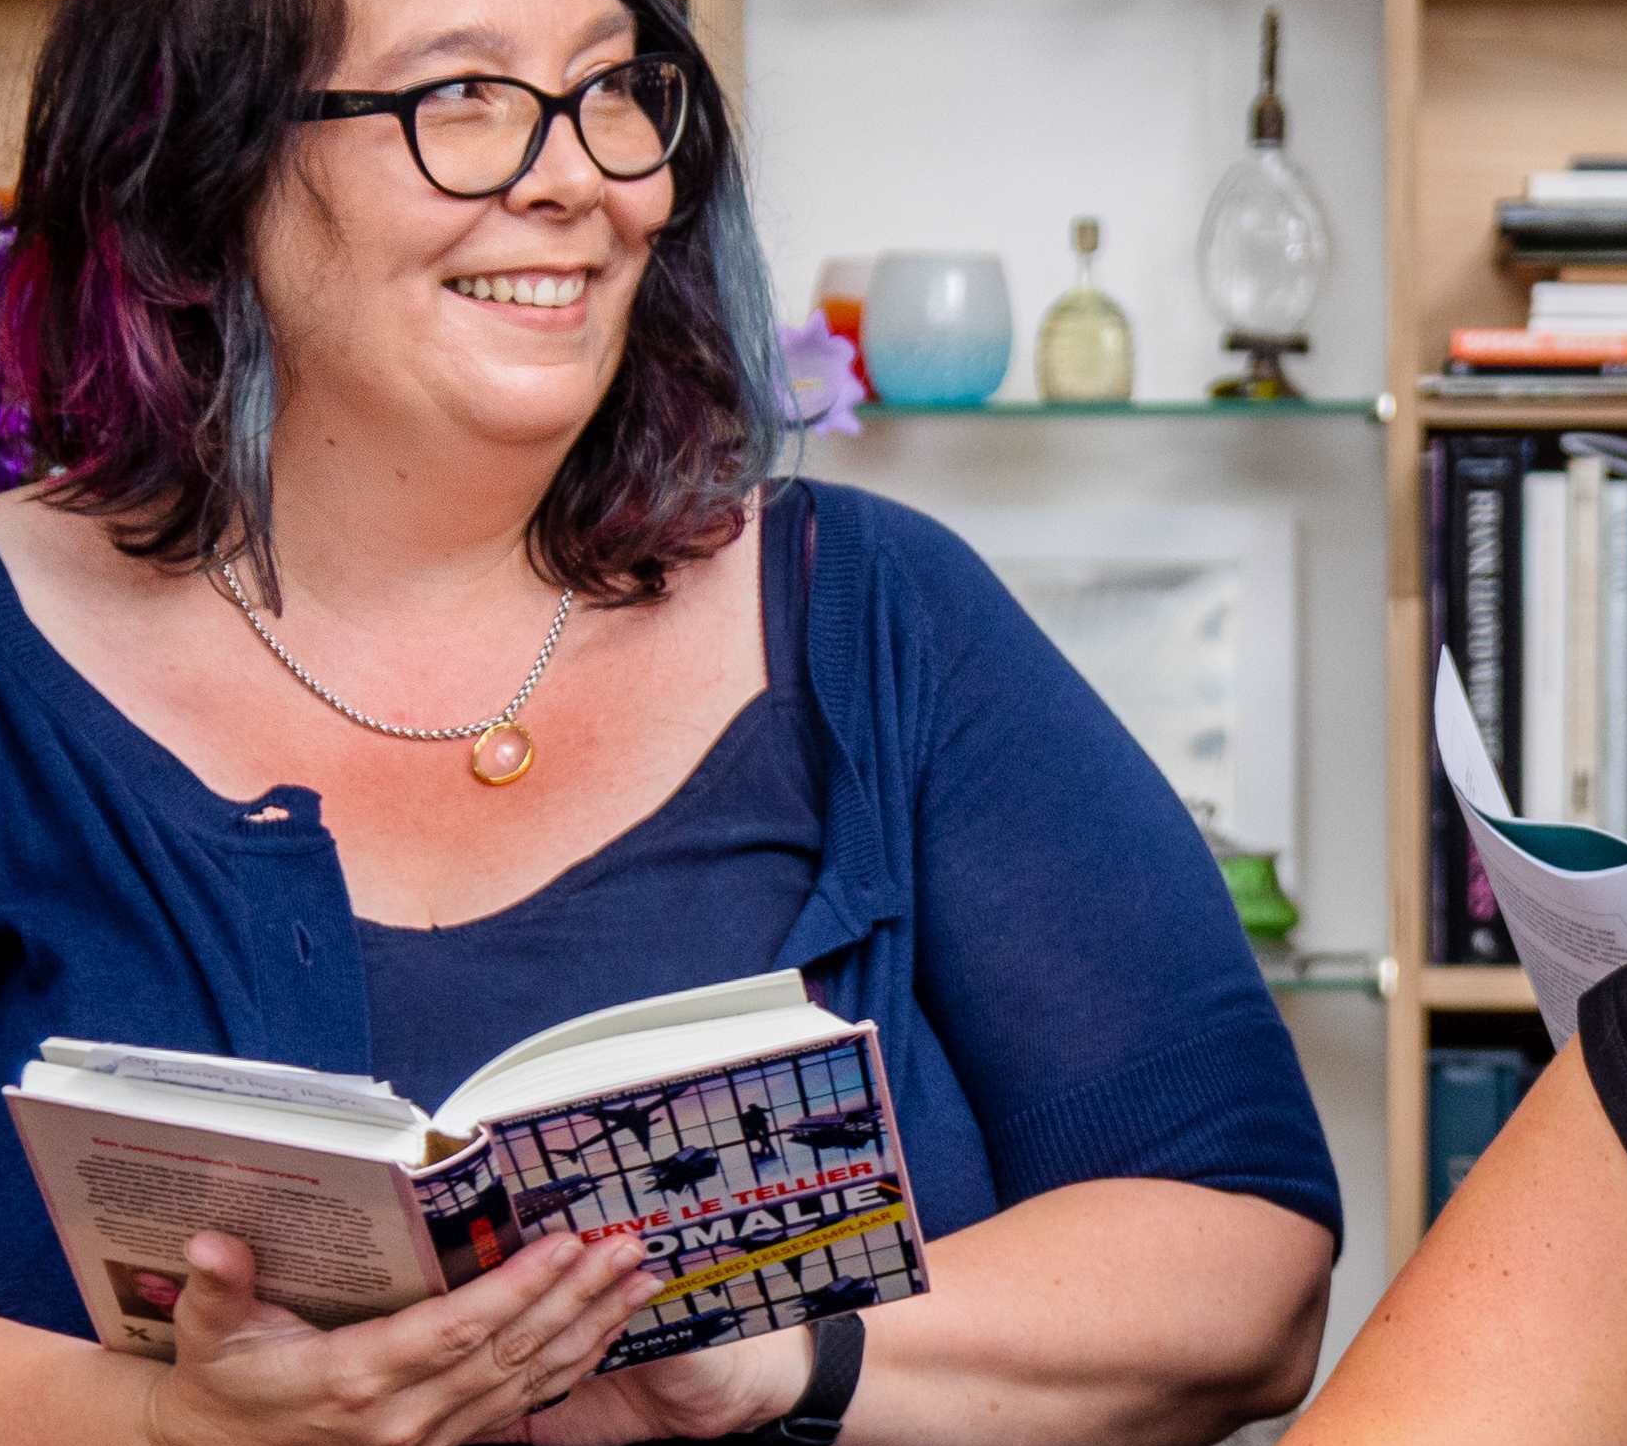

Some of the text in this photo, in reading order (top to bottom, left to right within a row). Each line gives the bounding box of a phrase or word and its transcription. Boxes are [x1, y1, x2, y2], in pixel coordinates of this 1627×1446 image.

[499, 1103, 568, 1128] WINNAAR
[581, 1160, 873, 1245] ERVÉ LE TELLIER
[644, 1186, 893, 1259] OMALIE
[750, 1210, 893, 1265] LEESEXEMPLAAR
[618, 1329, 694, 1353] ROMAN
